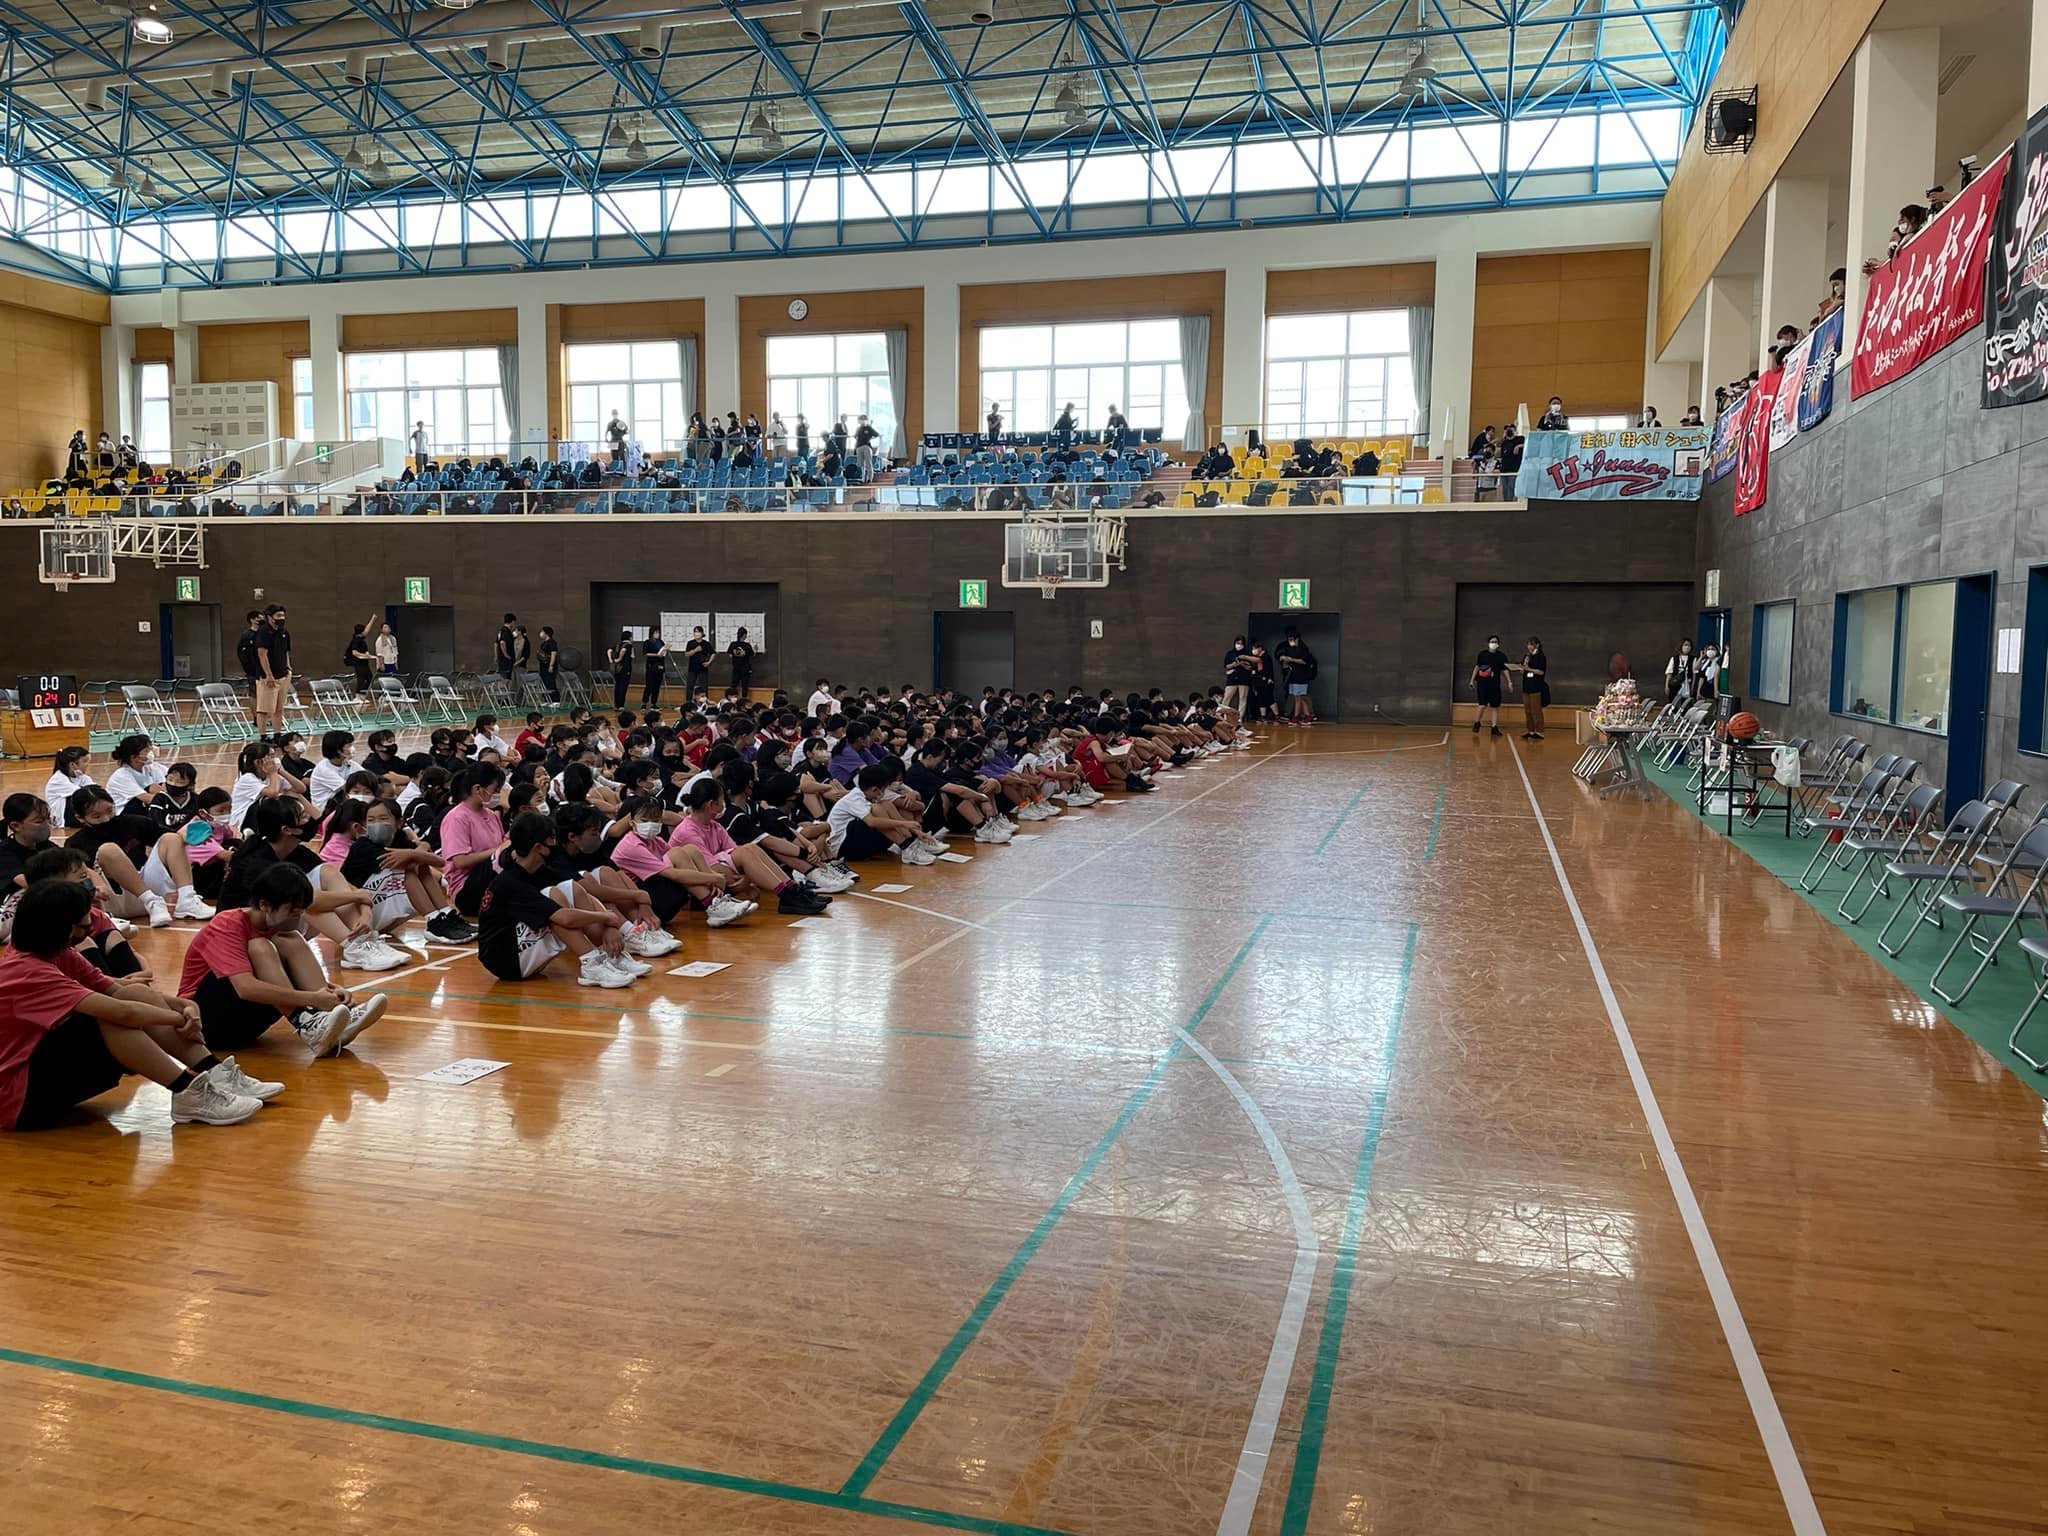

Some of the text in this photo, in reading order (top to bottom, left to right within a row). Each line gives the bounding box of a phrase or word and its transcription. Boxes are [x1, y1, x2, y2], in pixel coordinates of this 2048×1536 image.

[1581, 432, 1615, 448] 走れ！
[1620, 432, 1660, 447] 翔べ！
[1546, 449, 1670, 490] TJ Junior
[34, 694, 43, 708] 0
[44, 692, 58, 706] 24
[68, 692, 77, 706] 0
[35, 713, 53, 725] TJ
